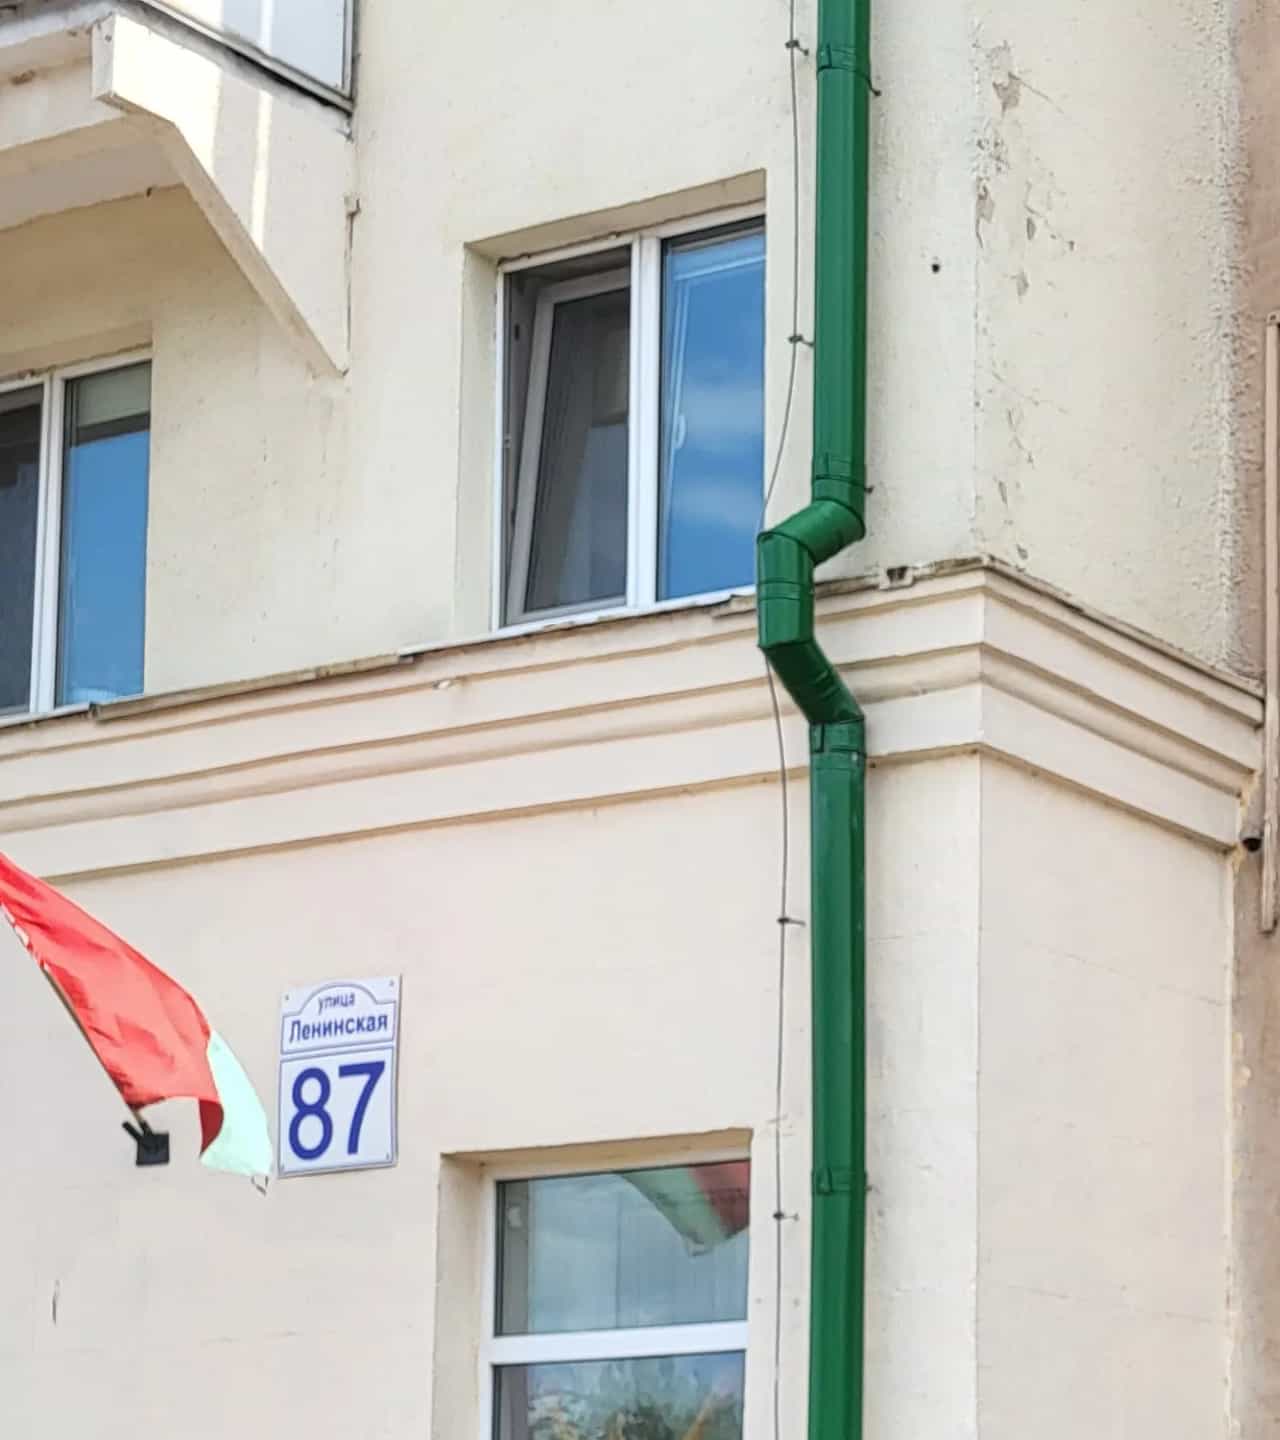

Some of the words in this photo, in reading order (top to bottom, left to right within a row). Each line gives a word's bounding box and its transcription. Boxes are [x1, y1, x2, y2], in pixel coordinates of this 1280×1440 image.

[318, 992, 355, 1014] улица
[289, 1014, 388, 1043] Ленинская
[288, 1061, 385, 1160] 87
